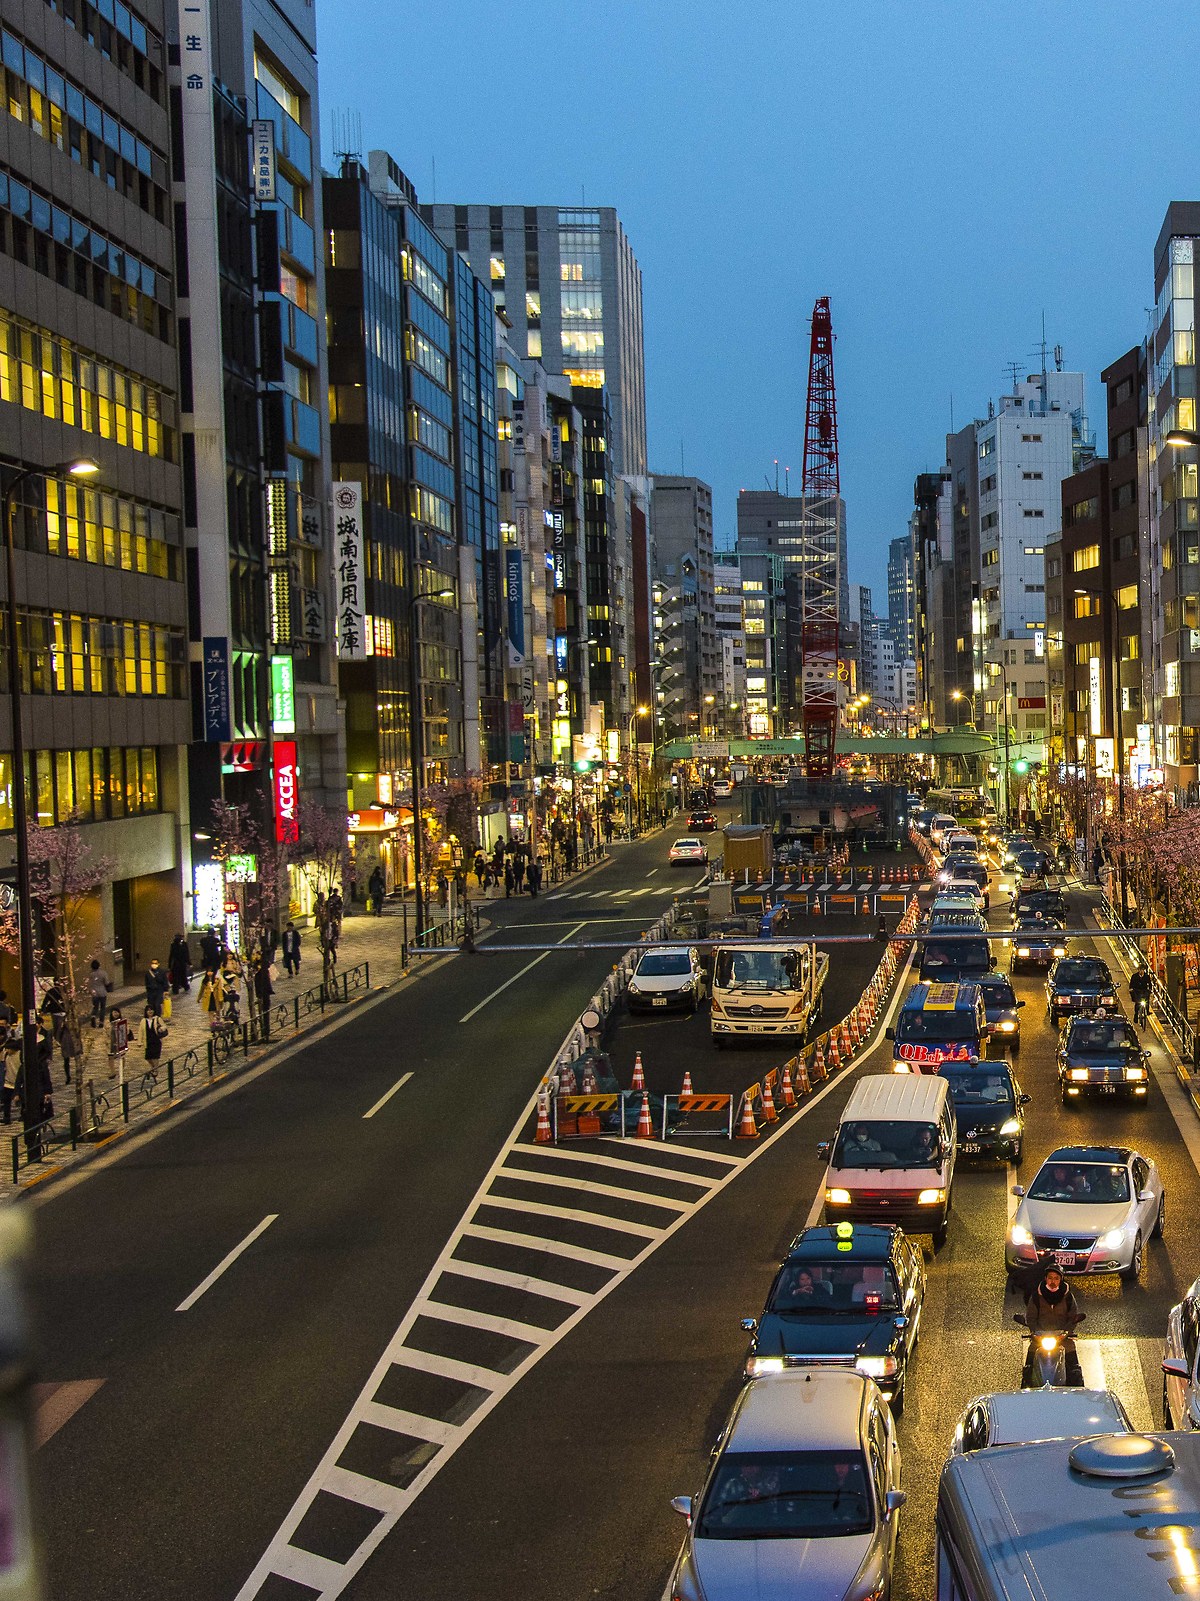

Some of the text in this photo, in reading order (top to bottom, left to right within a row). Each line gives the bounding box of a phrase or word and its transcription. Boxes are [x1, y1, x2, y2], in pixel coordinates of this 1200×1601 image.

[554, 513, 563, 544] コミック
[336, 515, 363, 656] 城南信用金庫
[509, 562, 519, 602] kinko's
[207, 669, 220, 729] プレアデス
[279, 764, 294, 820] ACCEA
